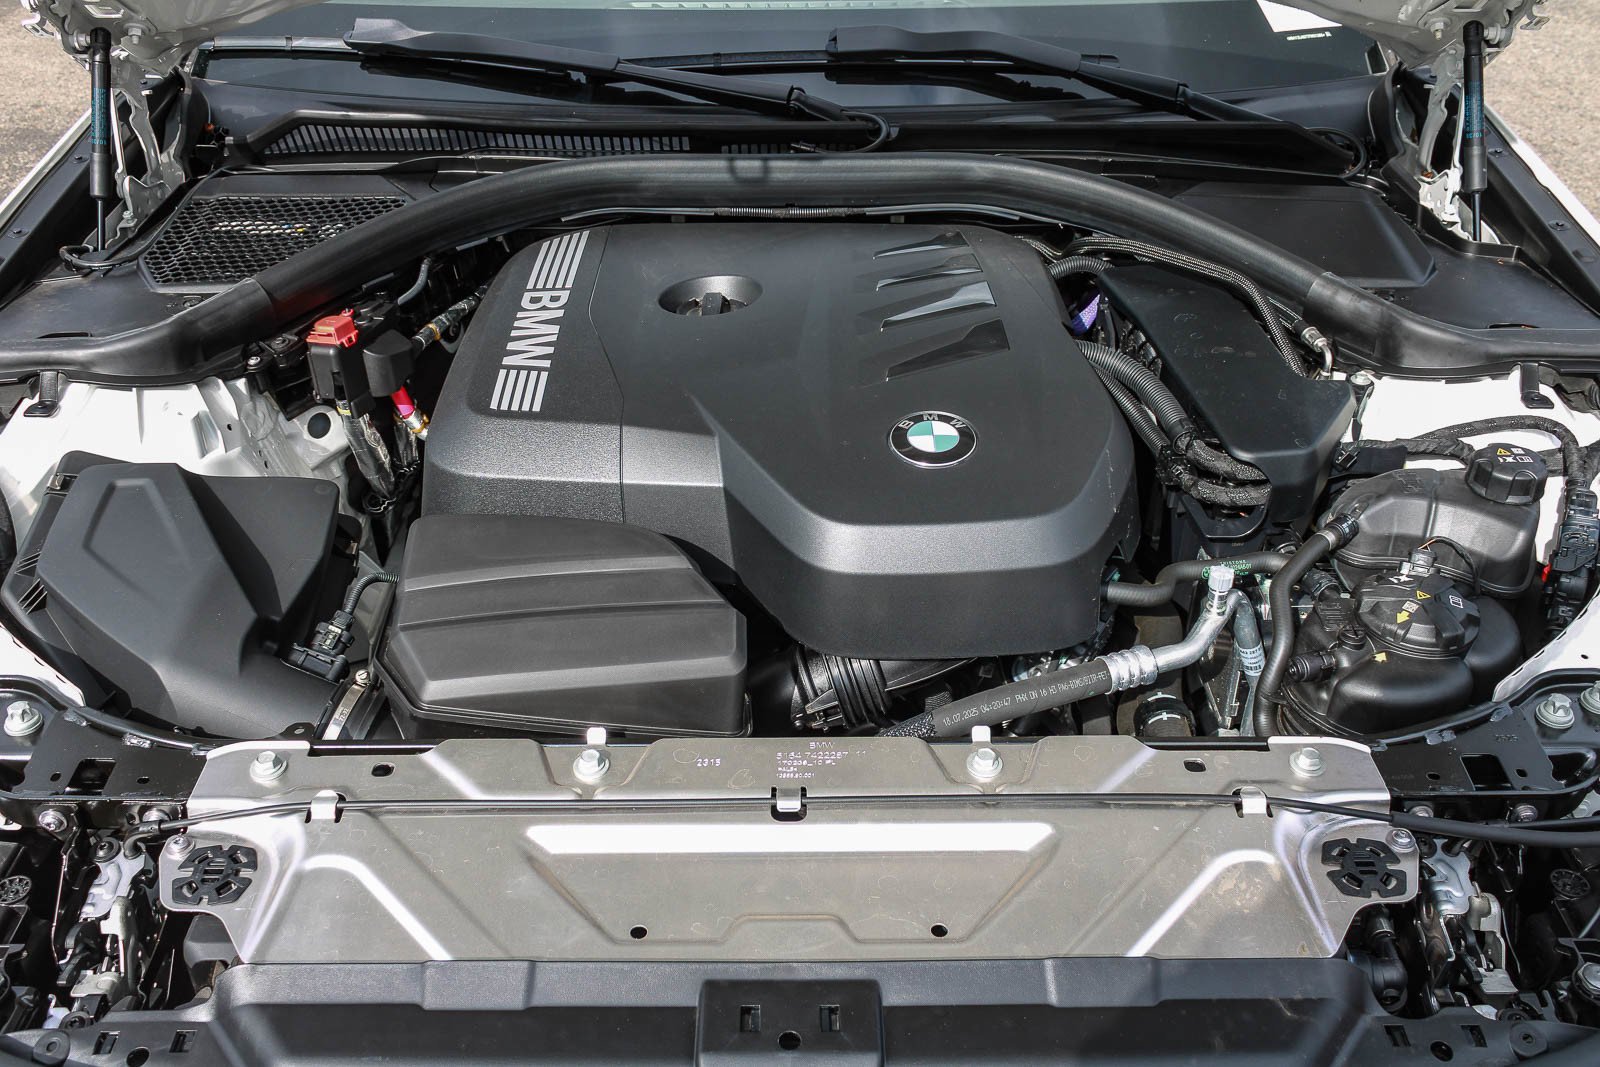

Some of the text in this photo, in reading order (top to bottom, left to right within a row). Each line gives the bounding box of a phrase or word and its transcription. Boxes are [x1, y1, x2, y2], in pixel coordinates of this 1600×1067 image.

[501, 289, 571, 368] BMW
[897, 413, 967, 430] BMW
[942, 707, 979, 727] 18.07.2025
[980, 697, 1012, 713] 04:20:47
[1039, 687, 1048, 697] 16
[808, 741, 834, 750] BMW
